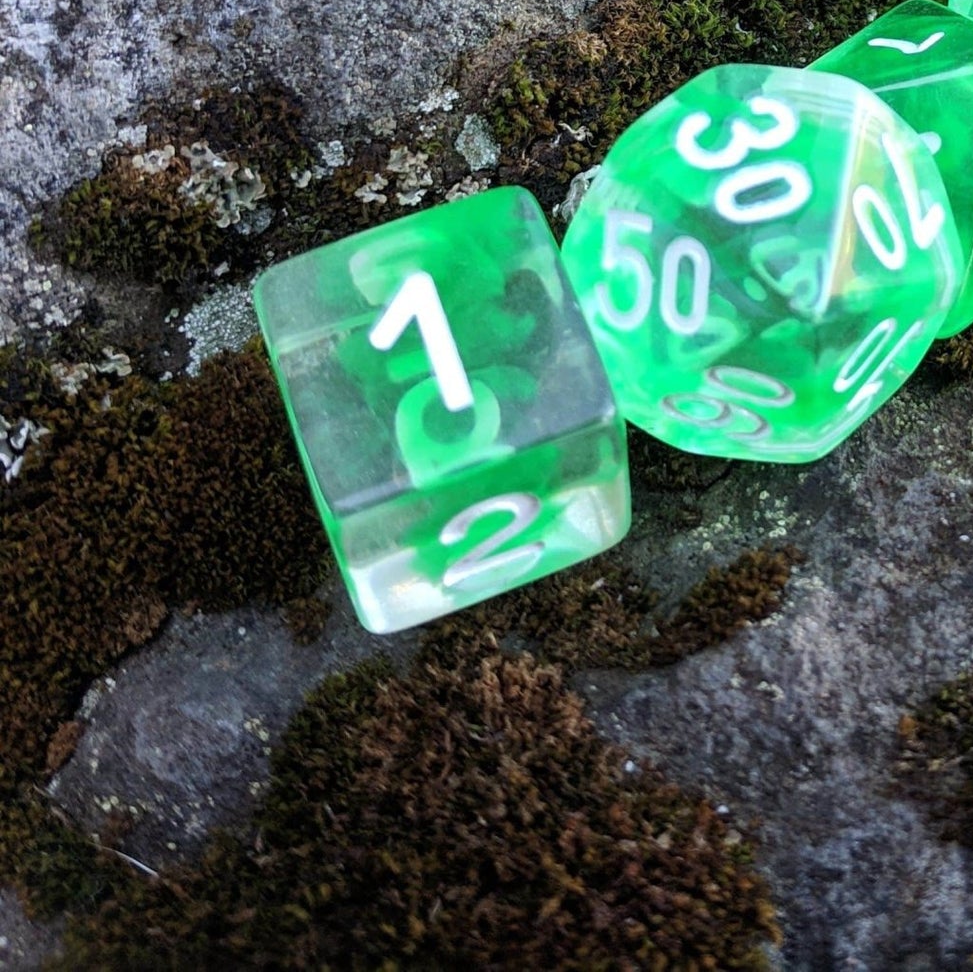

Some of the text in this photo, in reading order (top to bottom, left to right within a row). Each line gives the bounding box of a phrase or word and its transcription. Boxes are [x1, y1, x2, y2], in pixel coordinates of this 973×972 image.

[675, 95, 813, 224] 30
[595, 208, 712, 336] 50
[368, 272, 474, 411] 1
[662, 364, 796, 442] 90
[439, 491, 547, 588] 2
